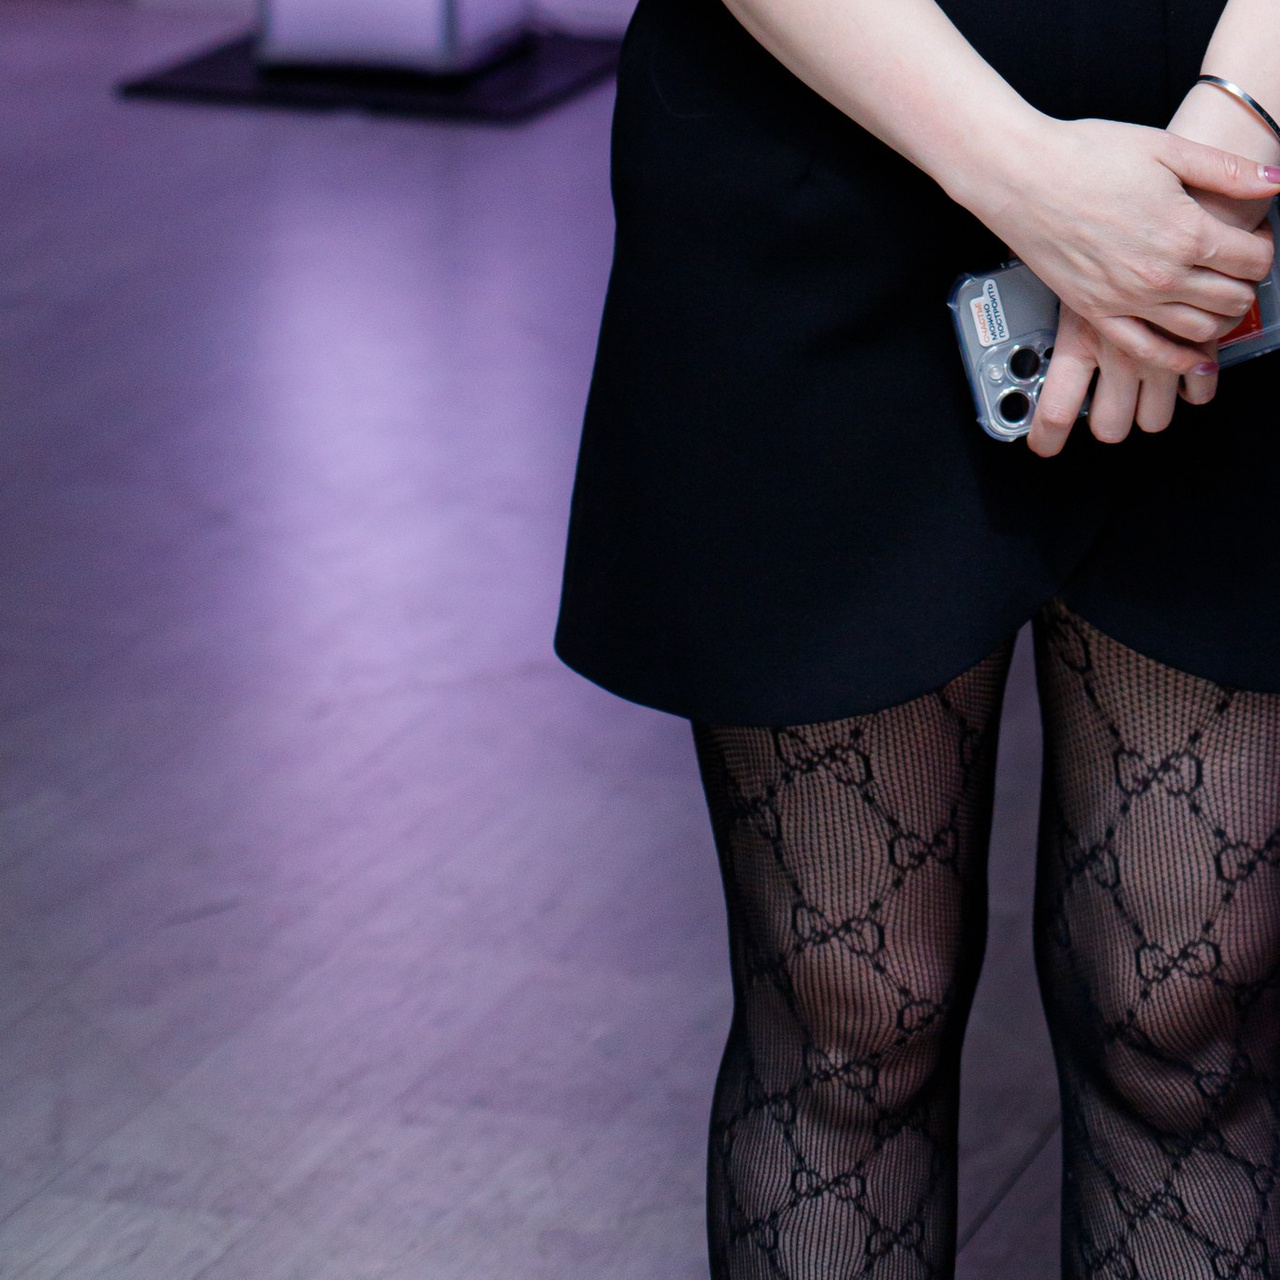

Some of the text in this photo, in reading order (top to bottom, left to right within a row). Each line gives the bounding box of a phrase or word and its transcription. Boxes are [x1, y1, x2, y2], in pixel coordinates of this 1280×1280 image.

[974, 302, 990, 343] СЧАСТЬЕ
[984, 303, 998, 341] МОЖНО
[987, 283, 1005, 339] ПОСТРОИТЬ
